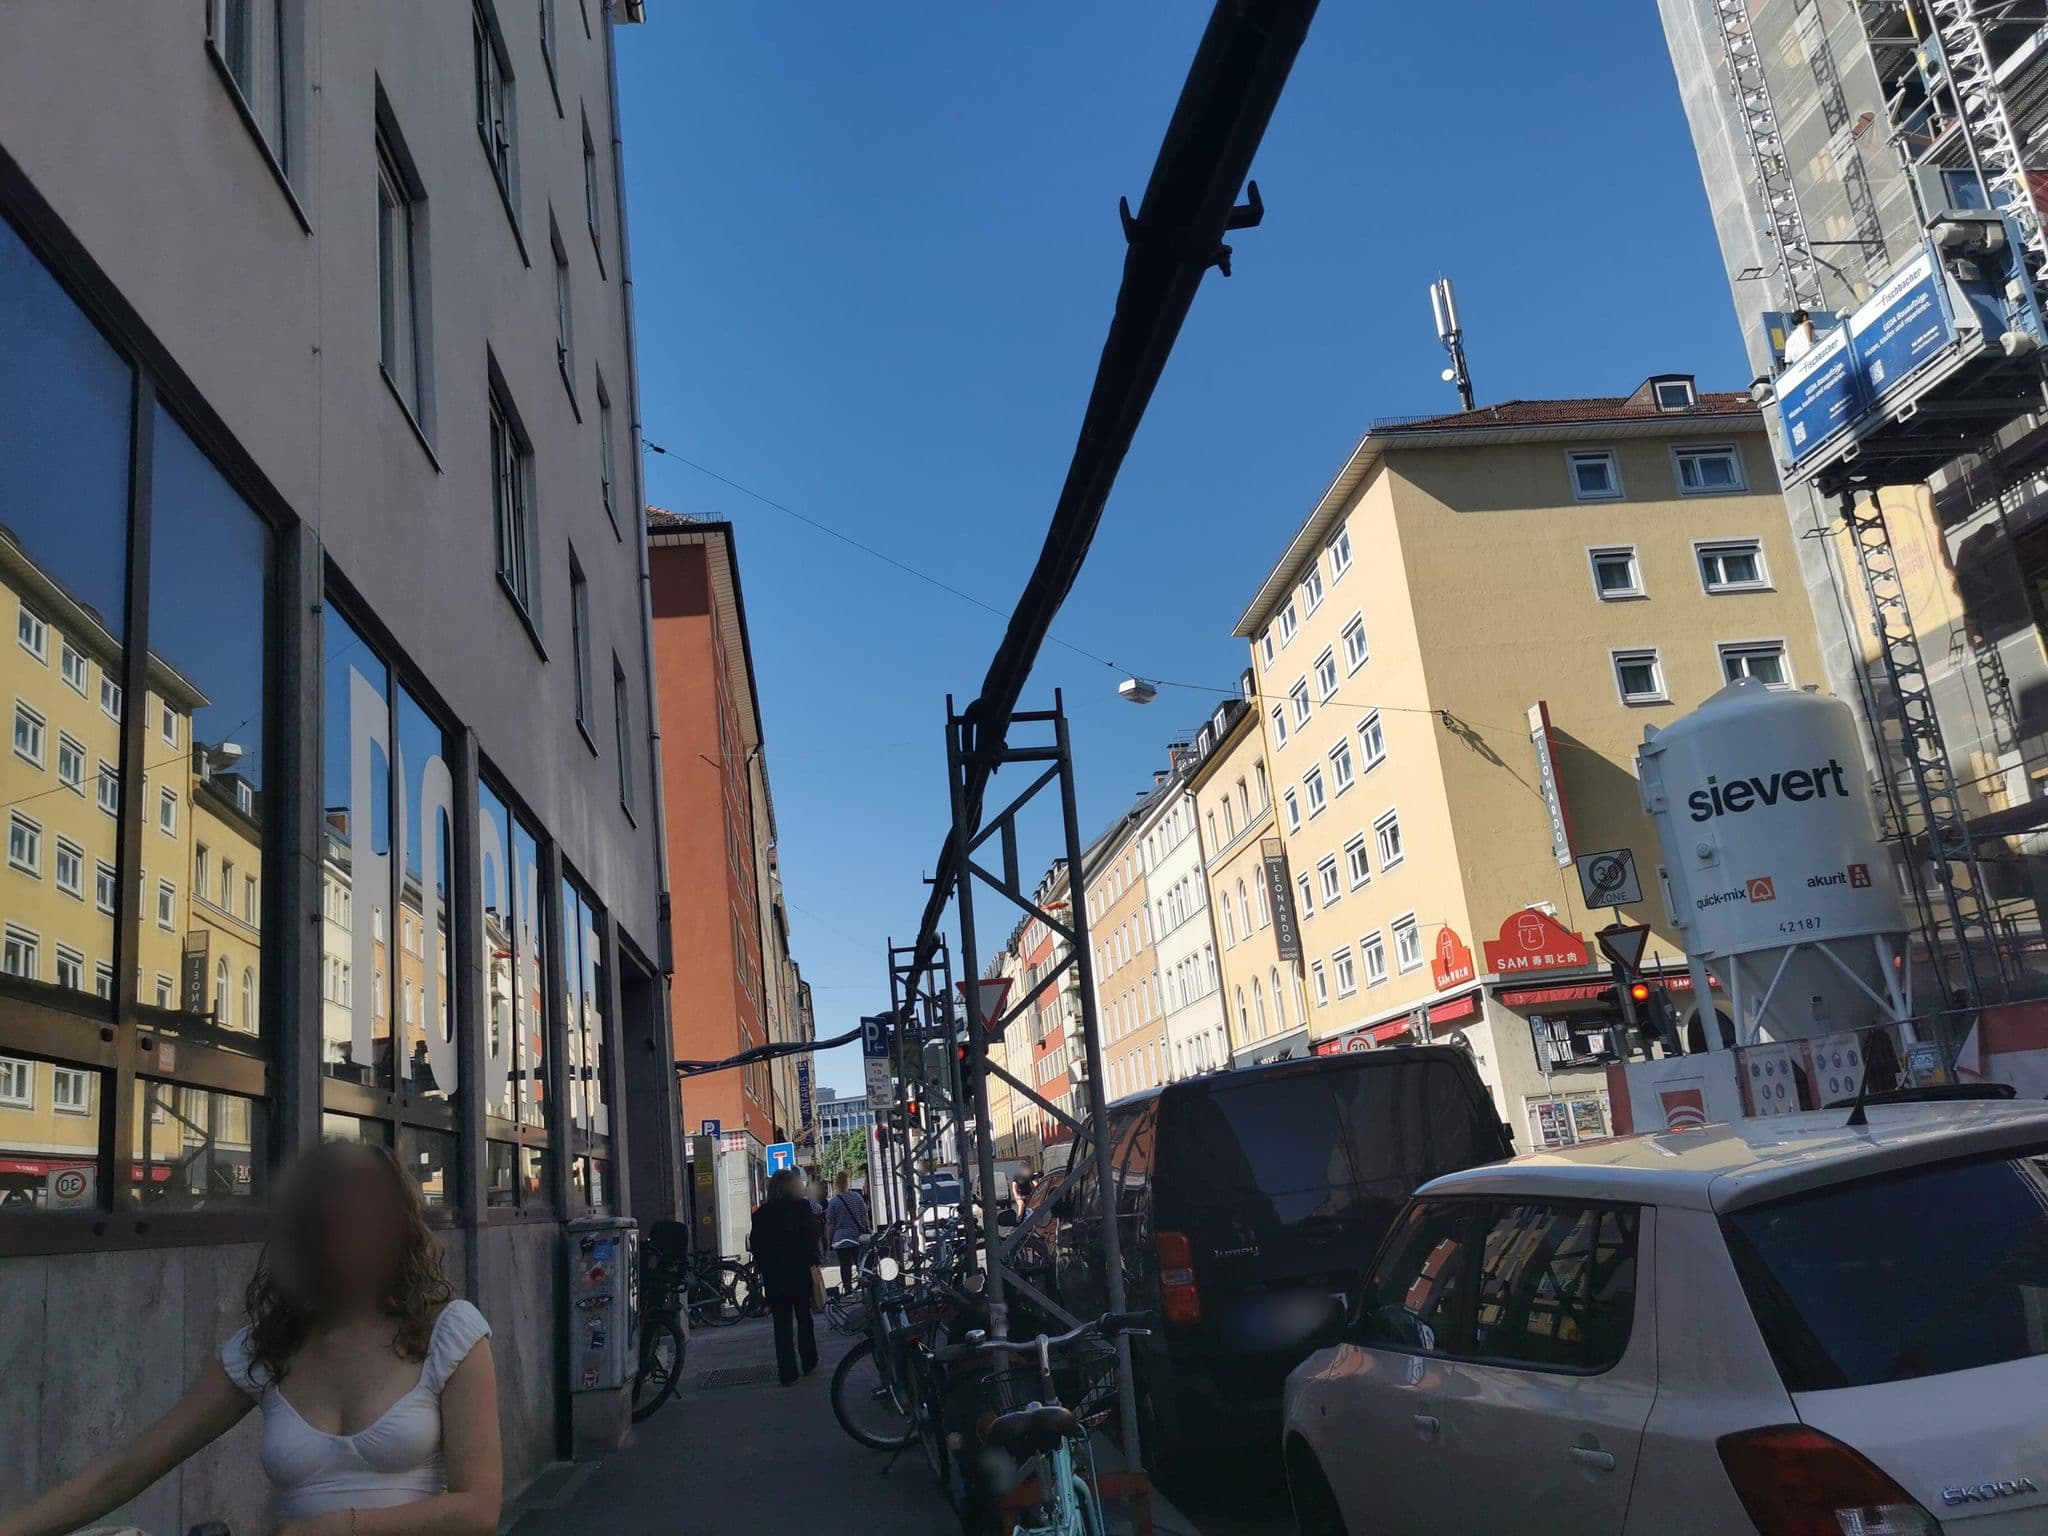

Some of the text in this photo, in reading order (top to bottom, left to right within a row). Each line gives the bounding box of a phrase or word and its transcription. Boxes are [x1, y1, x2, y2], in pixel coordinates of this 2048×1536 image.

[1538, 740, 1563, 842] LEONARDO
[1688, 759, 1849, 822] sievert
[1806, 871, 1848, 888] akurit
[1273, 864, 1292, 943] LEONARDO
[1696, 888, 1747, 911] quick-mix
[1779, 917, 1821, 934] 42187
[1497, 957, 1529, 970] SAM
[1552, 1020, 1570, 1041] YOU
[1942, 1477, 2040, 1505] ŠKODA
